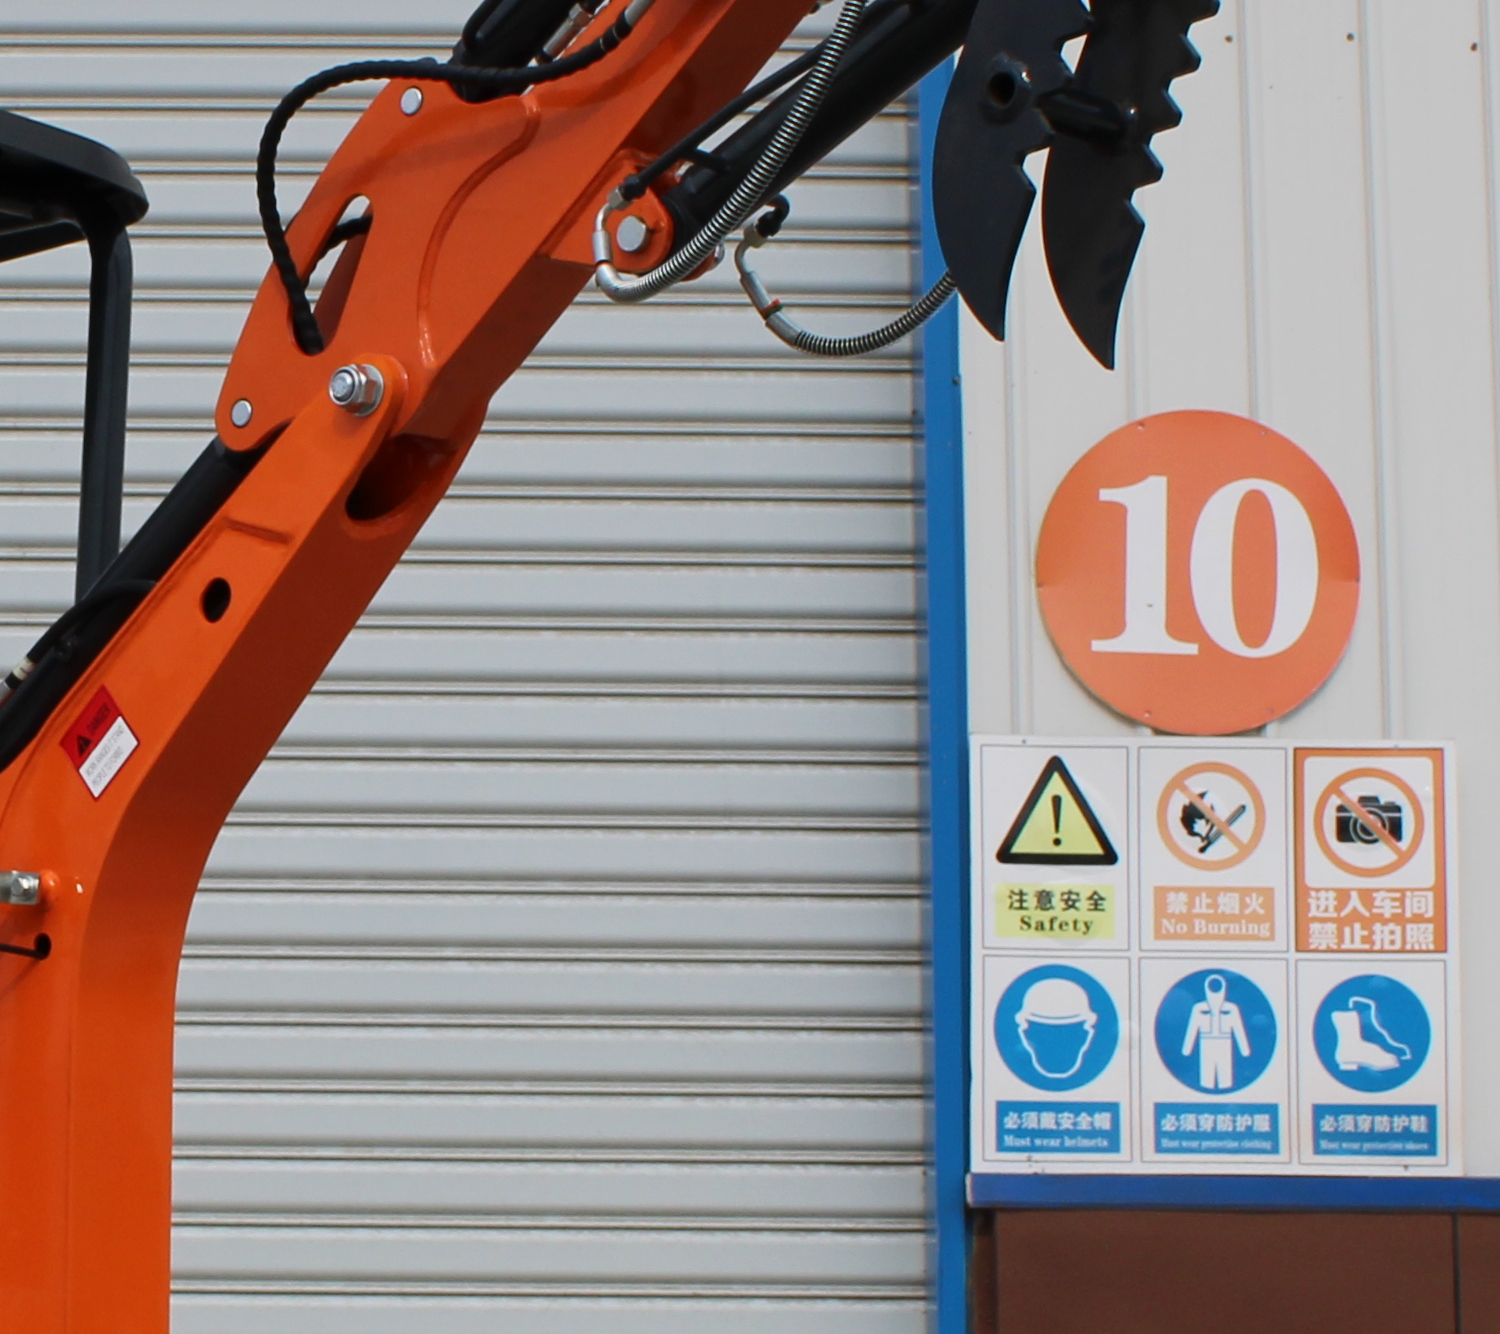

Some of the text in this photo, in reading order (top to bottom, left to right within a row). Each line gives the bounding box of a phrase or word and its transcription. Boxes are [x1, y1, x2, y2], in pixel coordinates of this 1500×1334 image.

[1091, 475, 1319, 658] 10
[1008, 889, 1107, 912] 注意安全
[1166, 891, 1266, 915] 禁止烟火
[1307, 890, 1435, 918] 进入车间
[1019, 915, 1093, 935] Safety
[1161, 918, 1271, 938] No Burning
[1308, 922, 1435, 950] 禁止拍照
[1003, 1111, 1113, 1130] 必须戴安全帽
[1160, 1113, 1271, 1132] 必须穿防护服
[1320, 1115, 1429, 1133] 必须穿防护鞋
[1003, 1135, 1109, 1147] Must wear helmets
